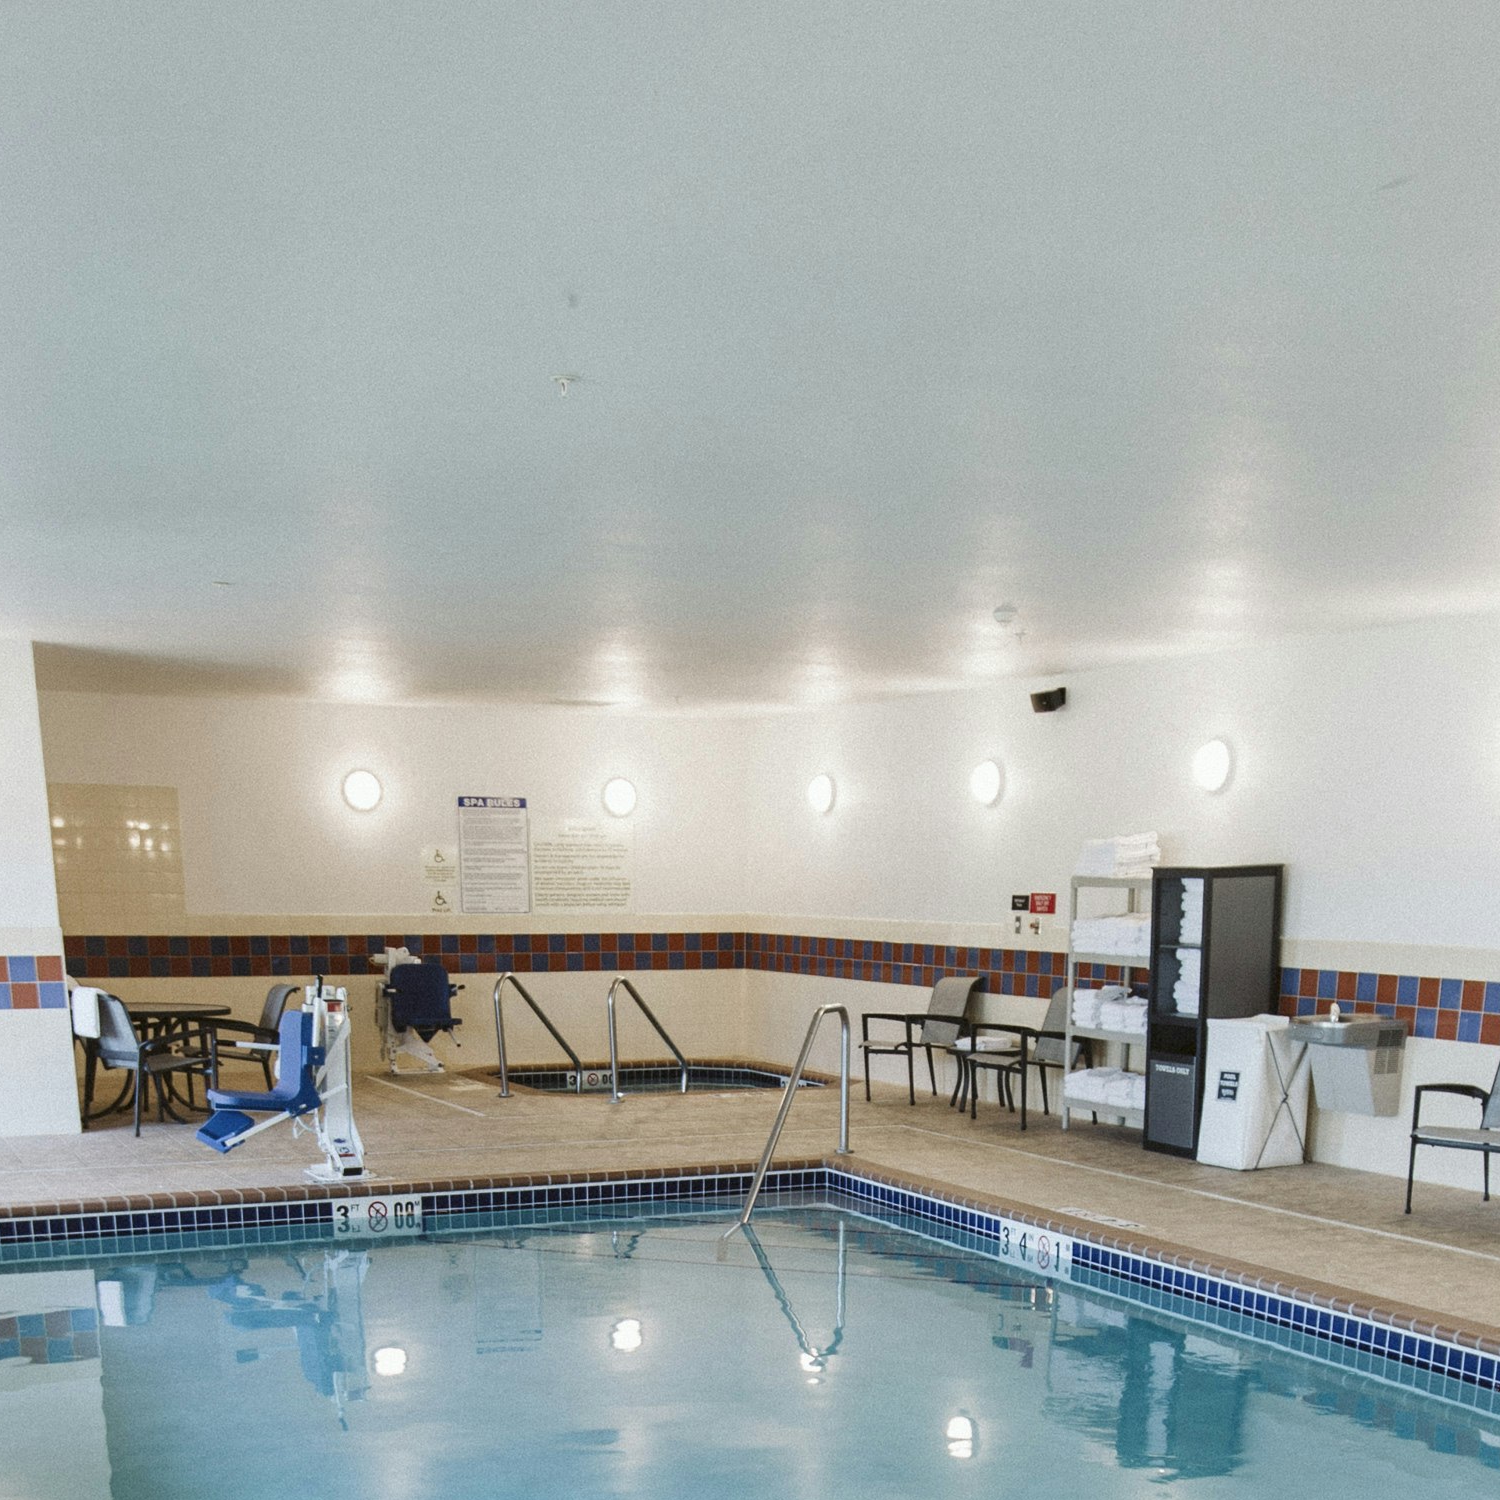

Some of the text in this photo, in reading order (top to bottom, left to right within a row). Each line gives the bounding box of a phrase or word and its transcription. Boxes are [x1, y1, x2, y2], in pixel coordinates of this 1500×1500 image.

[463, 798, 484, 806] SPA
[337, 1204, 349, 1219] 3
[1003, 1226, 1010, 1244] 3
[1019, 1232, 1027, 1248] 4
